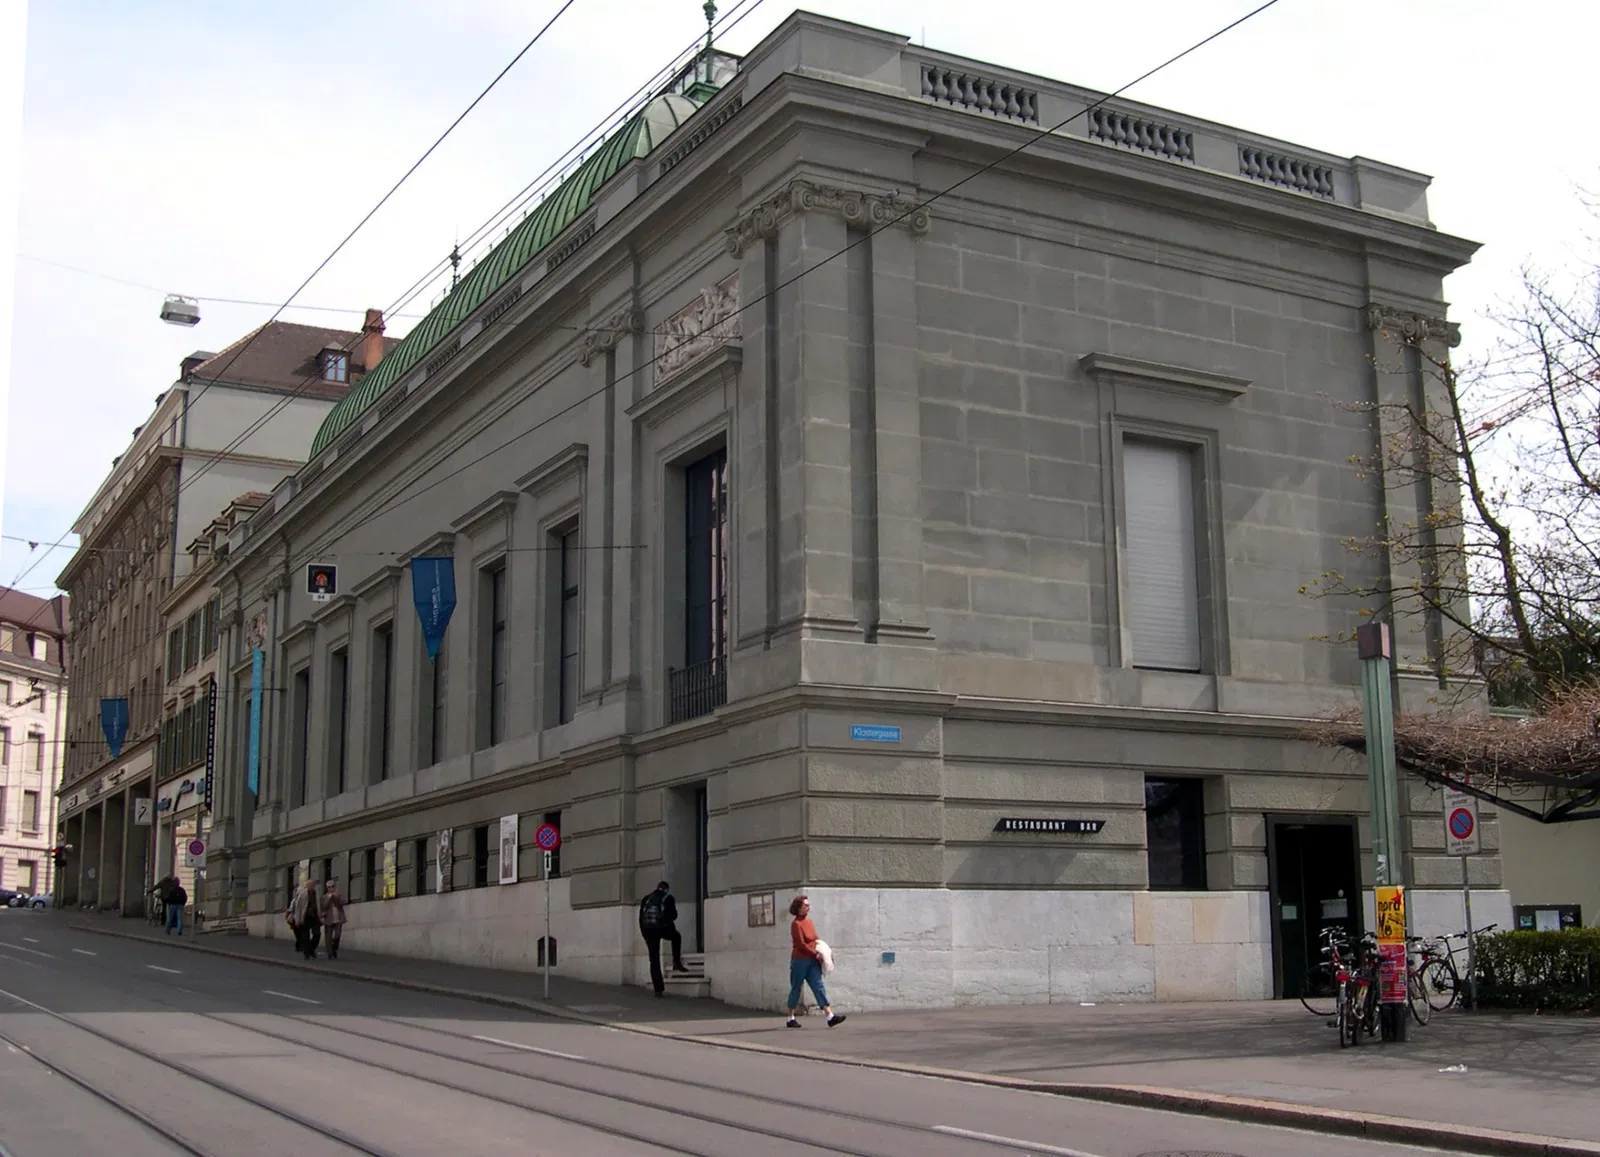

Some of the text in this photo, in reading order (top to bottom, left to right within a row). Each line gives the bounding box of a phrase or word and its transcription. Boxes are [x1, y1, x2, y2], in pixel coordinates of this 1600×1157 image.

[853, 726, 897, 739] Klostergasse
[1005, 820, 1097, 831] RESTAURANT BAR
